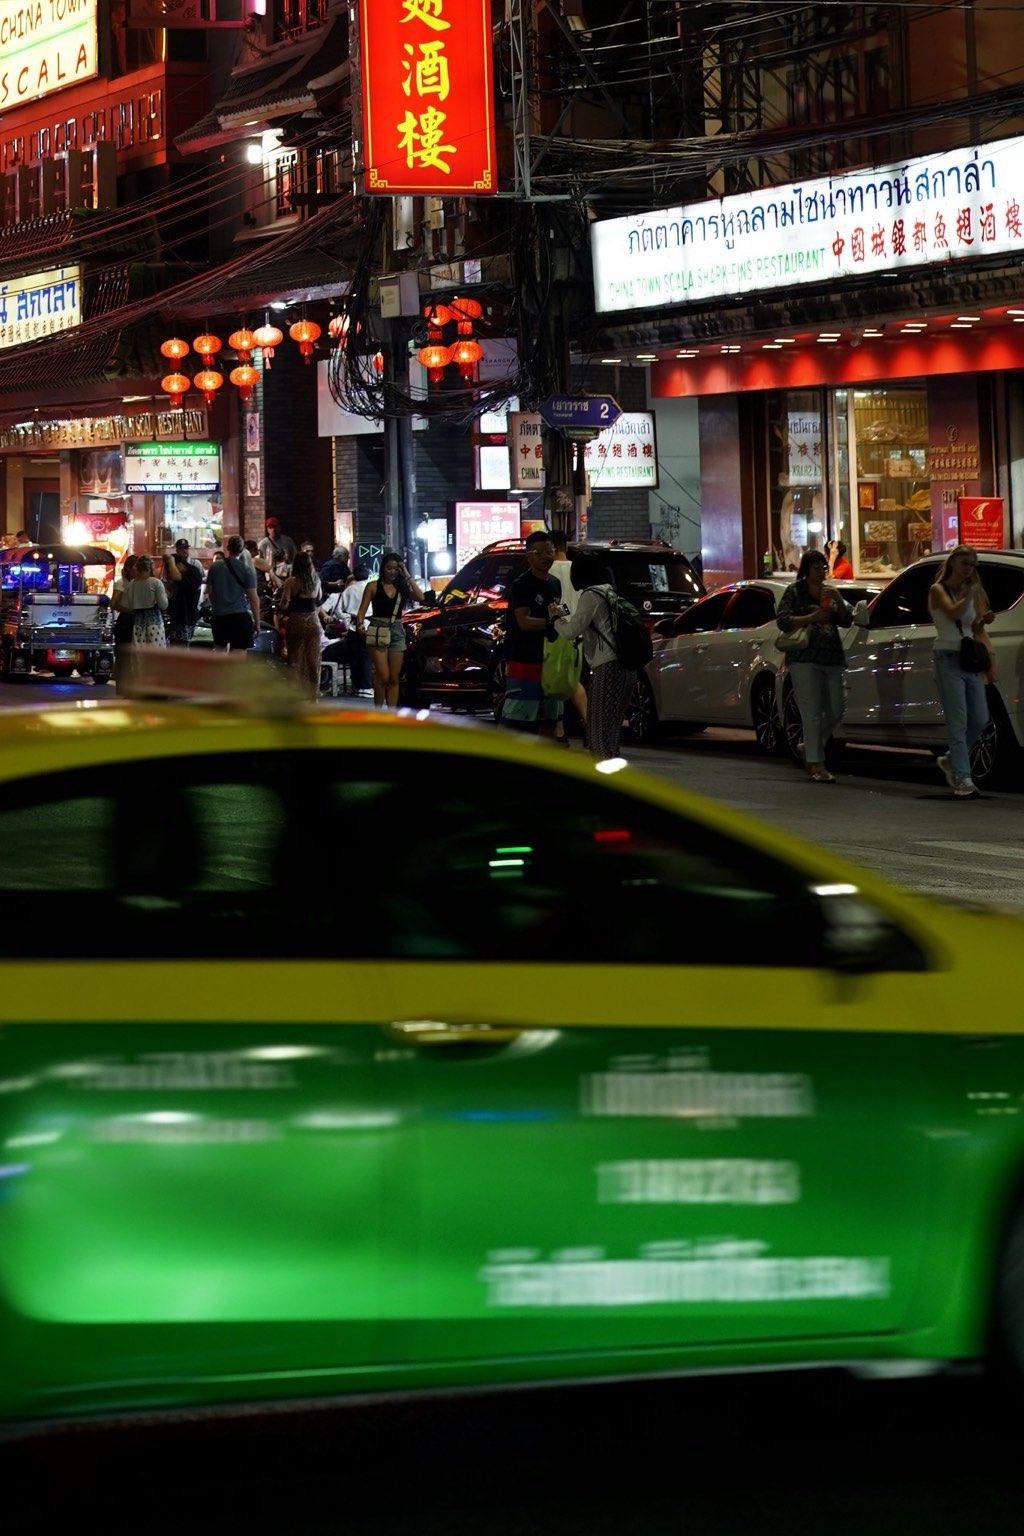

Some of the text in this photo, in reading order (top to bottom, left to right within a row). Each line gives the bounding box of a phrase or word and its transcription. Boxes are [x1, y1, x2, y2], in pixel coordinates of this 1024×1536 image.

[0, 1, 43, 46] CHINA
[1, 43, 88, 103] SCALA
[17, 269, 76, 320] สกาล่า
[609, 280, 635, 299] CHINA
[637, 277, 661, 295] TOWN
[663, 269, 694, 292] SCALA
[757, 248, 825, 276] RESTAURANT
[552, 401, 610, 419] เยาวราช 2
[521, 467, 541, 480] CHINA
[616, 465, 654, 479] RESTAURANT
